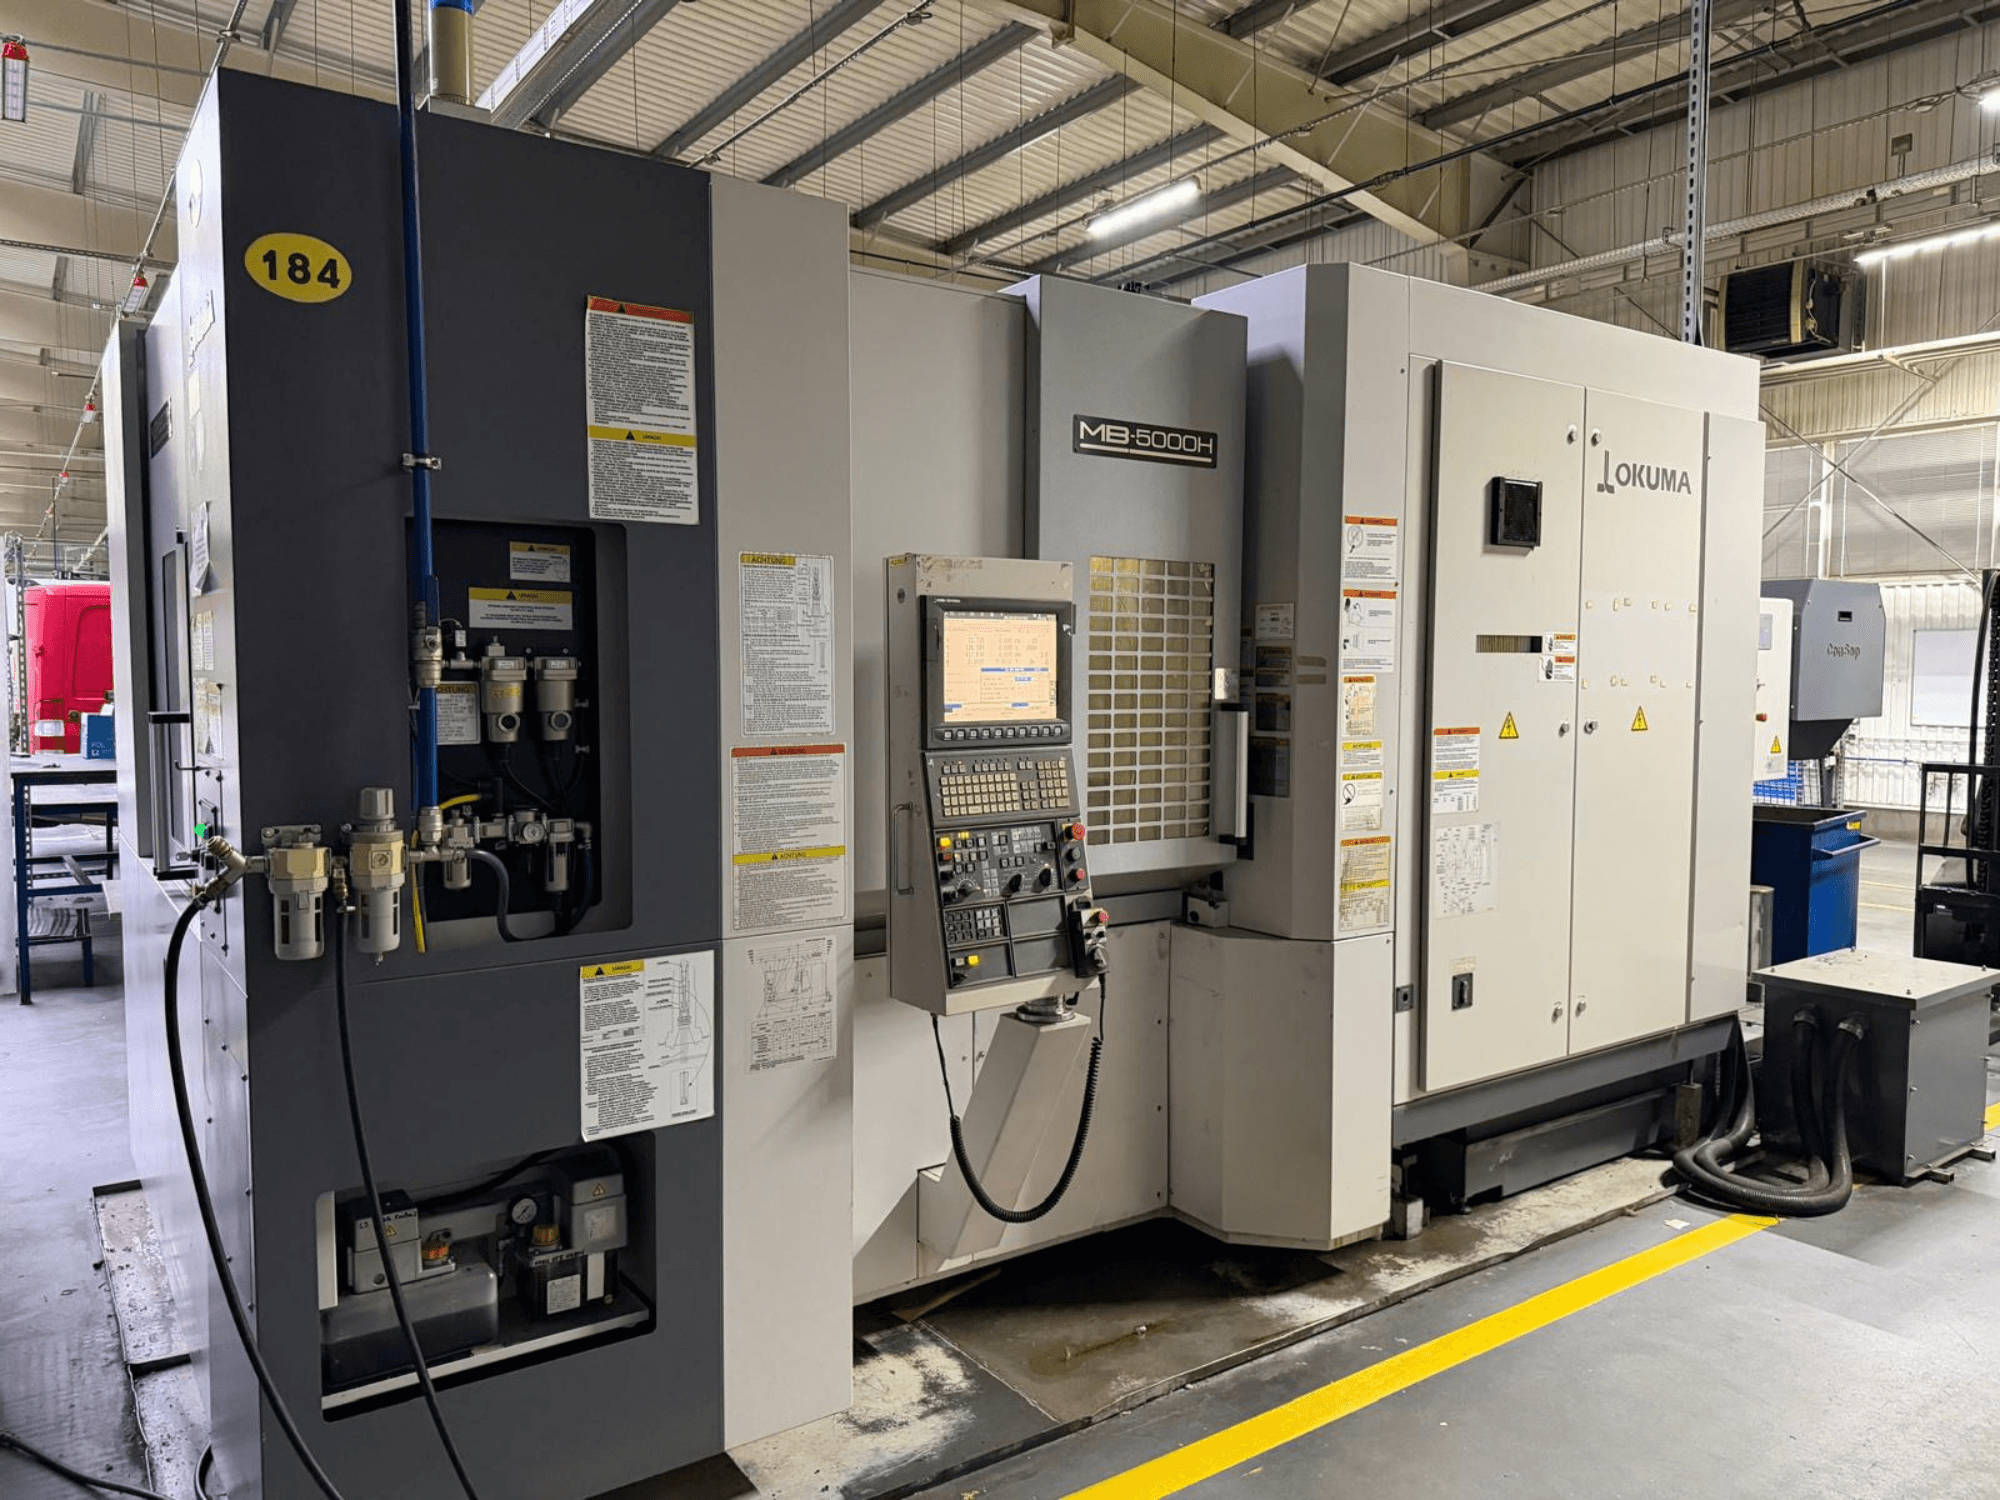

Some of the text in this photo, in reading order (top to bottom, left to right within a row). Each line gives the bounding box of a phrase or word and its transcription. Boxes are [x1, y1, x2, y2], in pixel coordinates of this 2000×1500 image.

[263, 249, 340, 289] 184
[1079, 420, 1213, 454] MB-5000H
[1614, 462, 1692, 495] OKUMA
[751, 555, 787, 565] ACHTUNG
[435, 685, 471, 694] CHTUNG
[780, 851, 806, 860] ACHTUNG
